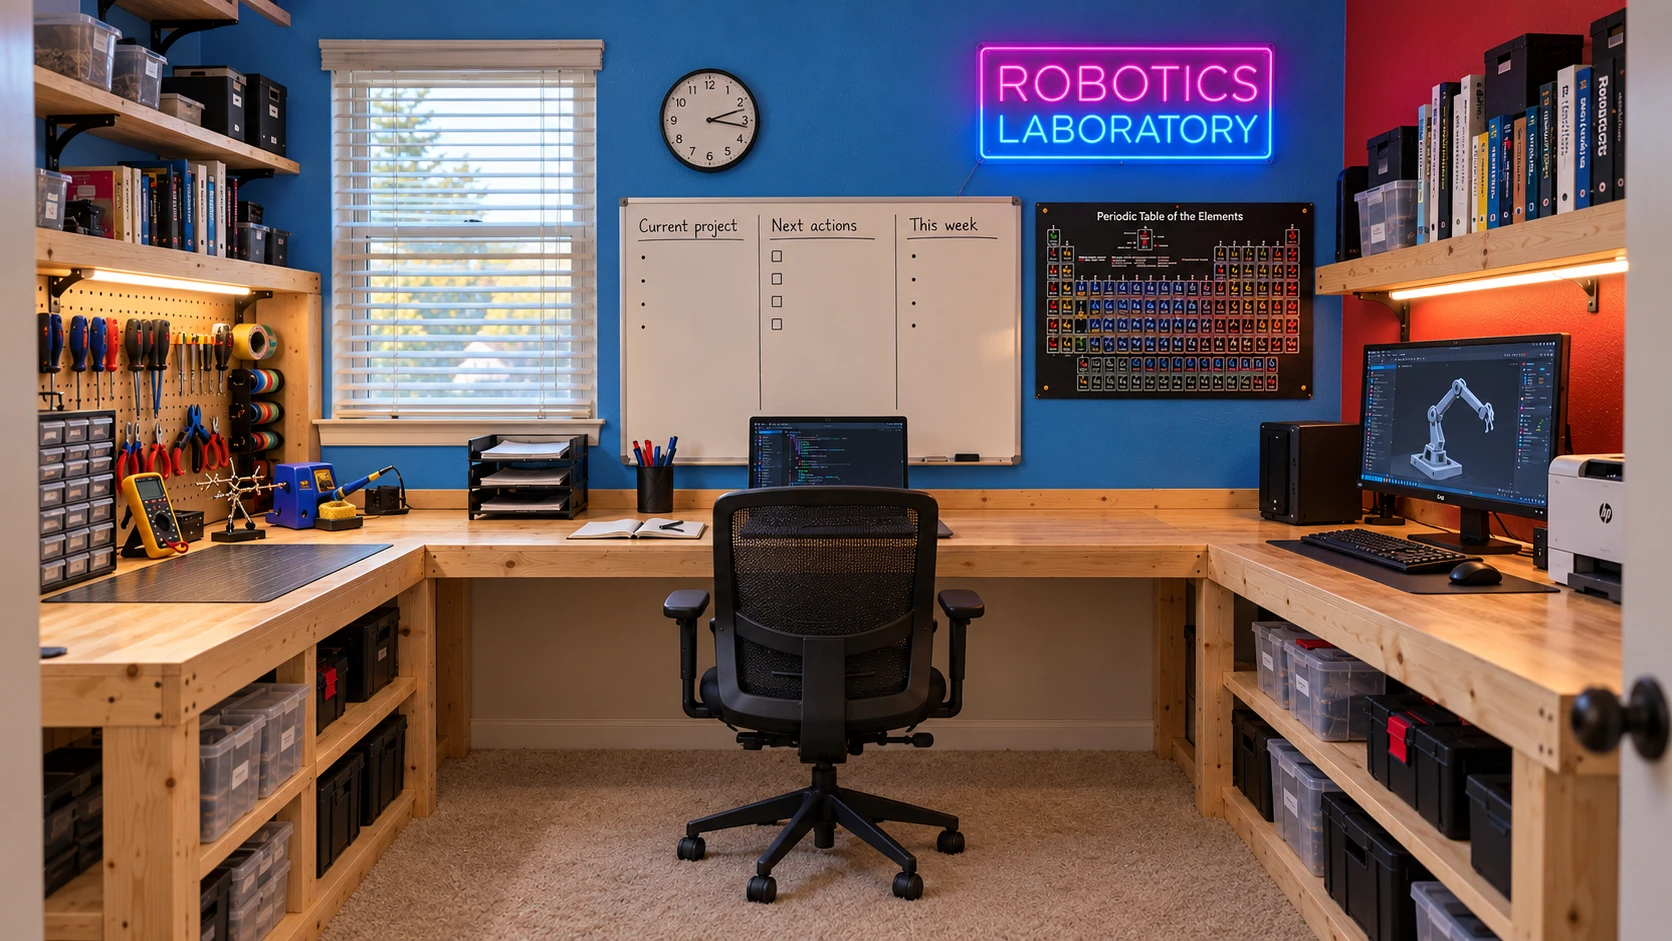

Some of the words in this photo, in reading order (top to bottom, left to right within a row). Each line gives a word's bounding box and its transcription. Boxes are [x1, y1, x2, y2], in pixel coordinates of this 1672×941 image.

[705, 80, 715, 90] 12
[999, 65, 1257, 102] ROBOTICS
[689, 85, 696, 95] 11
[726, 85, 730, 95] 1
[676, 97, 686, 107] 10
[737, 97, 744, 107] 2
[670, 115, 677, 126] 9
[742, 115, 748, 126] 3
[999, 114, 1258, 144] LABORATORY
[676, 134, 683, 144] 8
[736, 134, 743, 143] 4
[689, 146, 696, 156] 7
[706, 152, 714, 160] 6
[724, 146, 731, 156] 5
[1097, 211, 1137, 221] Periodic
[1139, 211, 1165, 221] Table
[1167, 211, 1178, 221] of
[1180, 211, 1196, 221] the
[1198, 211, 1244, 221] Elements
[639, 218, 688, 232] Current
[695, 218, 738, 238] project
[772, 218, 804, 232] Next
[810, 218, 857, 232] actions
[909, 217, 938, 232] This
[945, 217, 978, 231] week
[1600, 503, 1612, 524] hp
